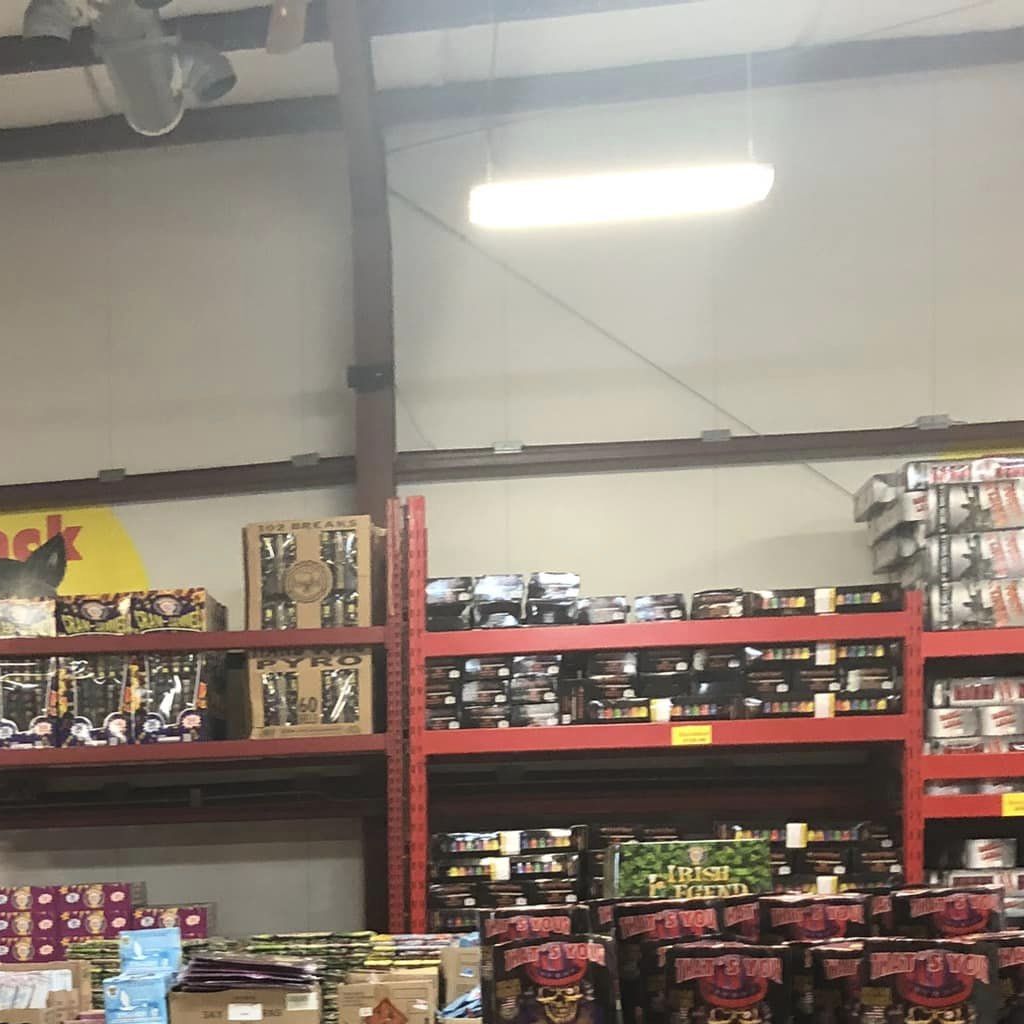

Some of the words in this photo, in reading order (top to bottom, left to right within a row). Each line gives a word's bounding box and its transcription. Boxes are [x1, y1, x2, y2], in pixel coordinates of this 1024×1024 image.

[291, 519, 358, 530] BREAKS
[257, 655, 362, 669] PYRO
[667, 865, 730, 884] IRISH
[648, 873, 750, 898] LEGEND
